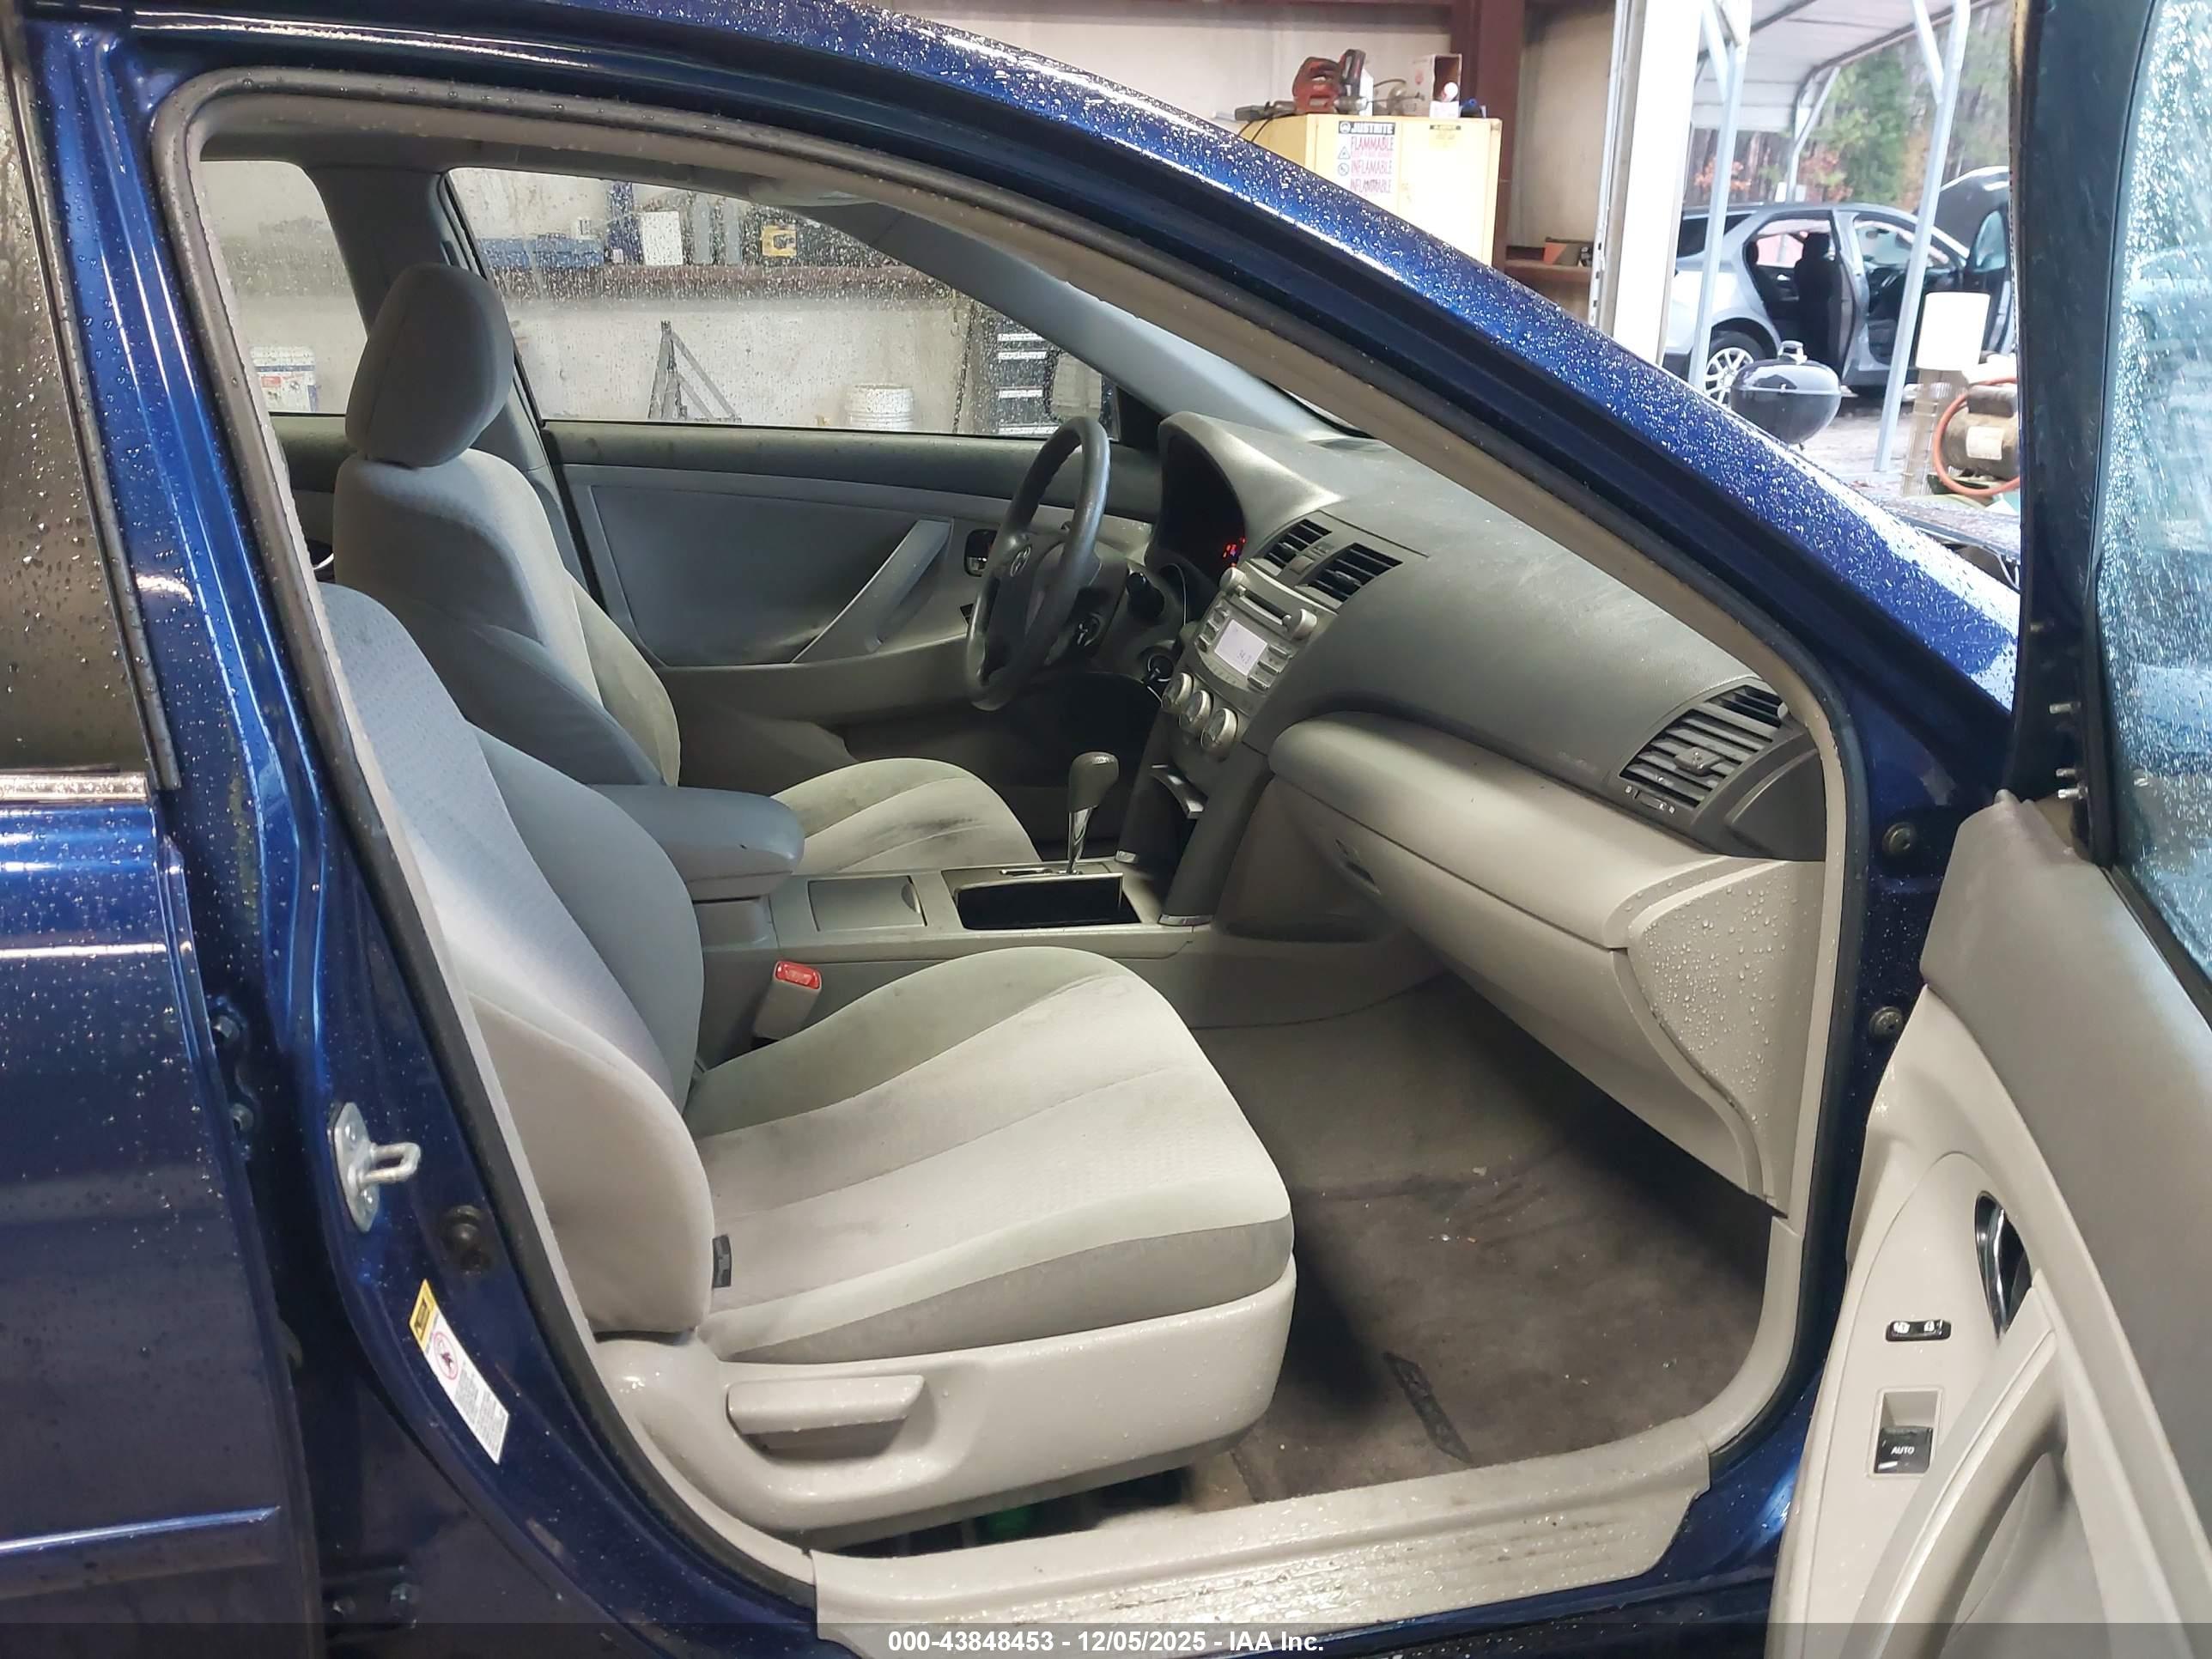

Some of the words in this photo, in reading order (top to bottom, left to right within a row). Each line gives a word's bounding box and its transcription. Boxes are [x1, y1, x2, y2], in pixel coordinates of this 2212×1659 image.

[1351, 122, 1394, 134] JUSTRITE
[1351, 137, 1394, 151] FLAMMABLE
[1351, 160, 1392, 174] INFLAMABLE
[1891, 1446, 1915, 1455] AUTO
